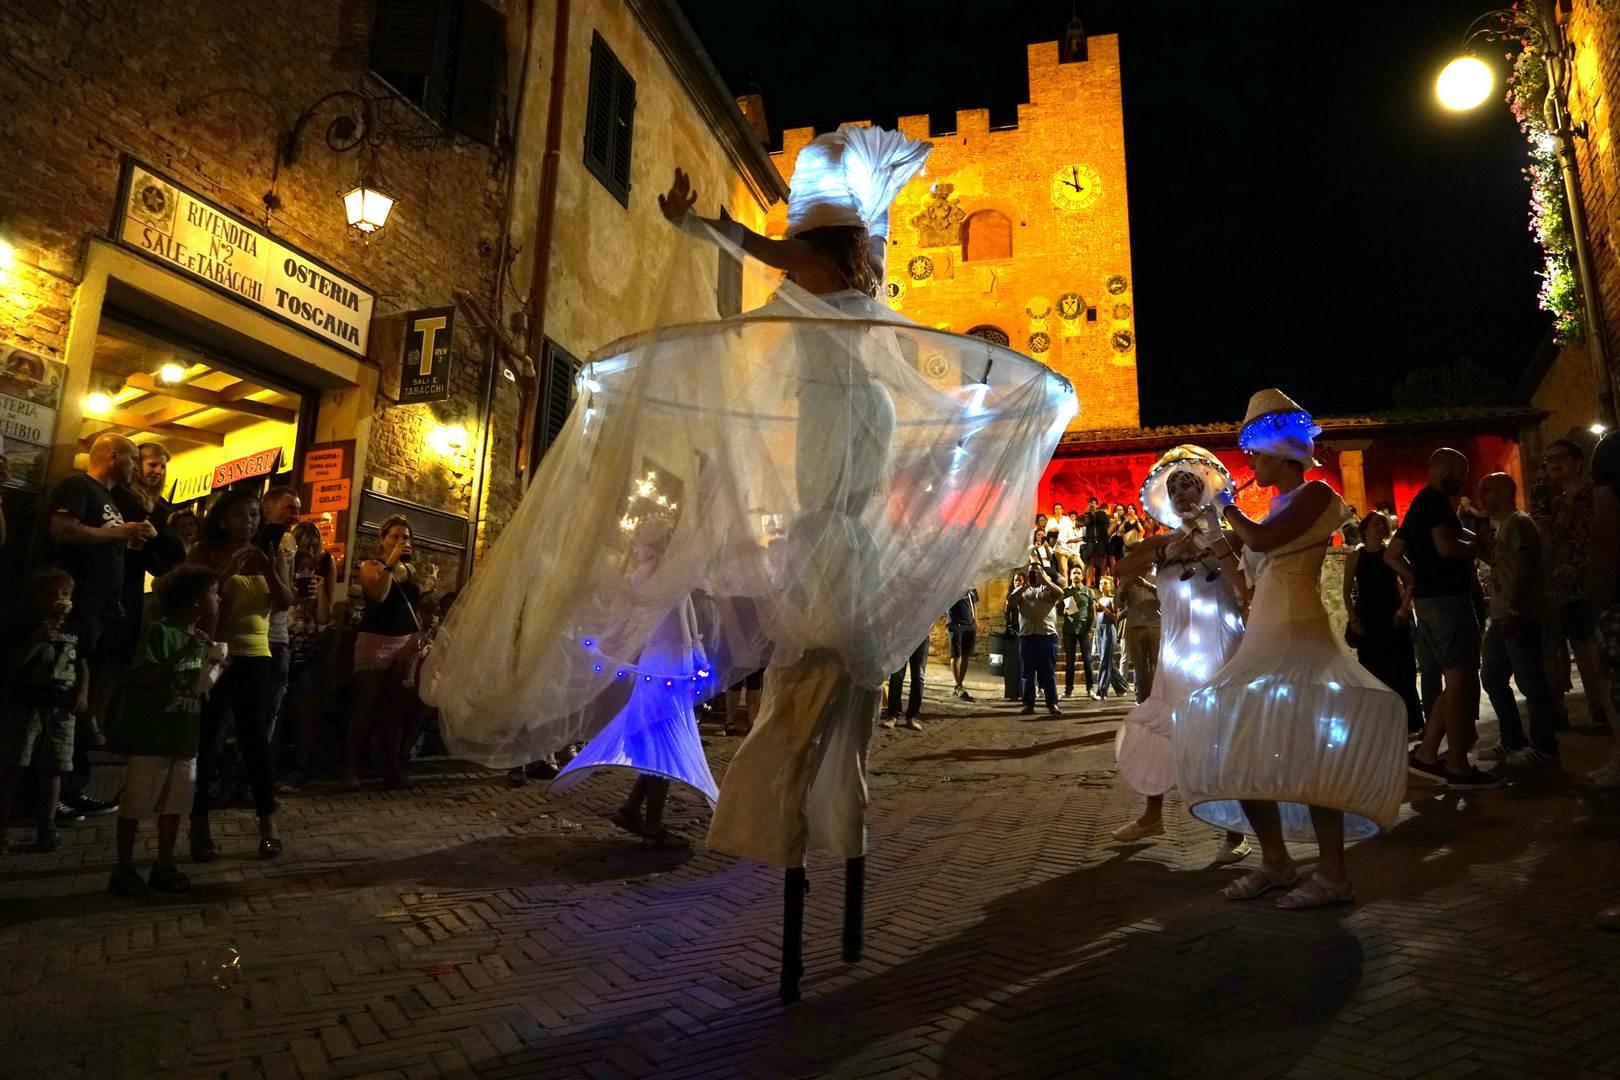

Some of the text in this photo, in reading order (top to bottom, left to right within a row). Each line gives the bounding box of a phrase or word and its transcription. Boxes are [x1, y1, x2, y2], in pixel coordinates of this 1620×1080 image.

[188, 201, 257, 257] RIVENDITA
[142, 228, 188, 268] SALE
[196, 253, 263, 302] TABACCHI
[284, 258, 359, 313] OSTERIA
[275, 288, 360, 346] TOSCANA
[413, 316, 447, 376] T
[404, 383, 444, 396] TABACCHI
